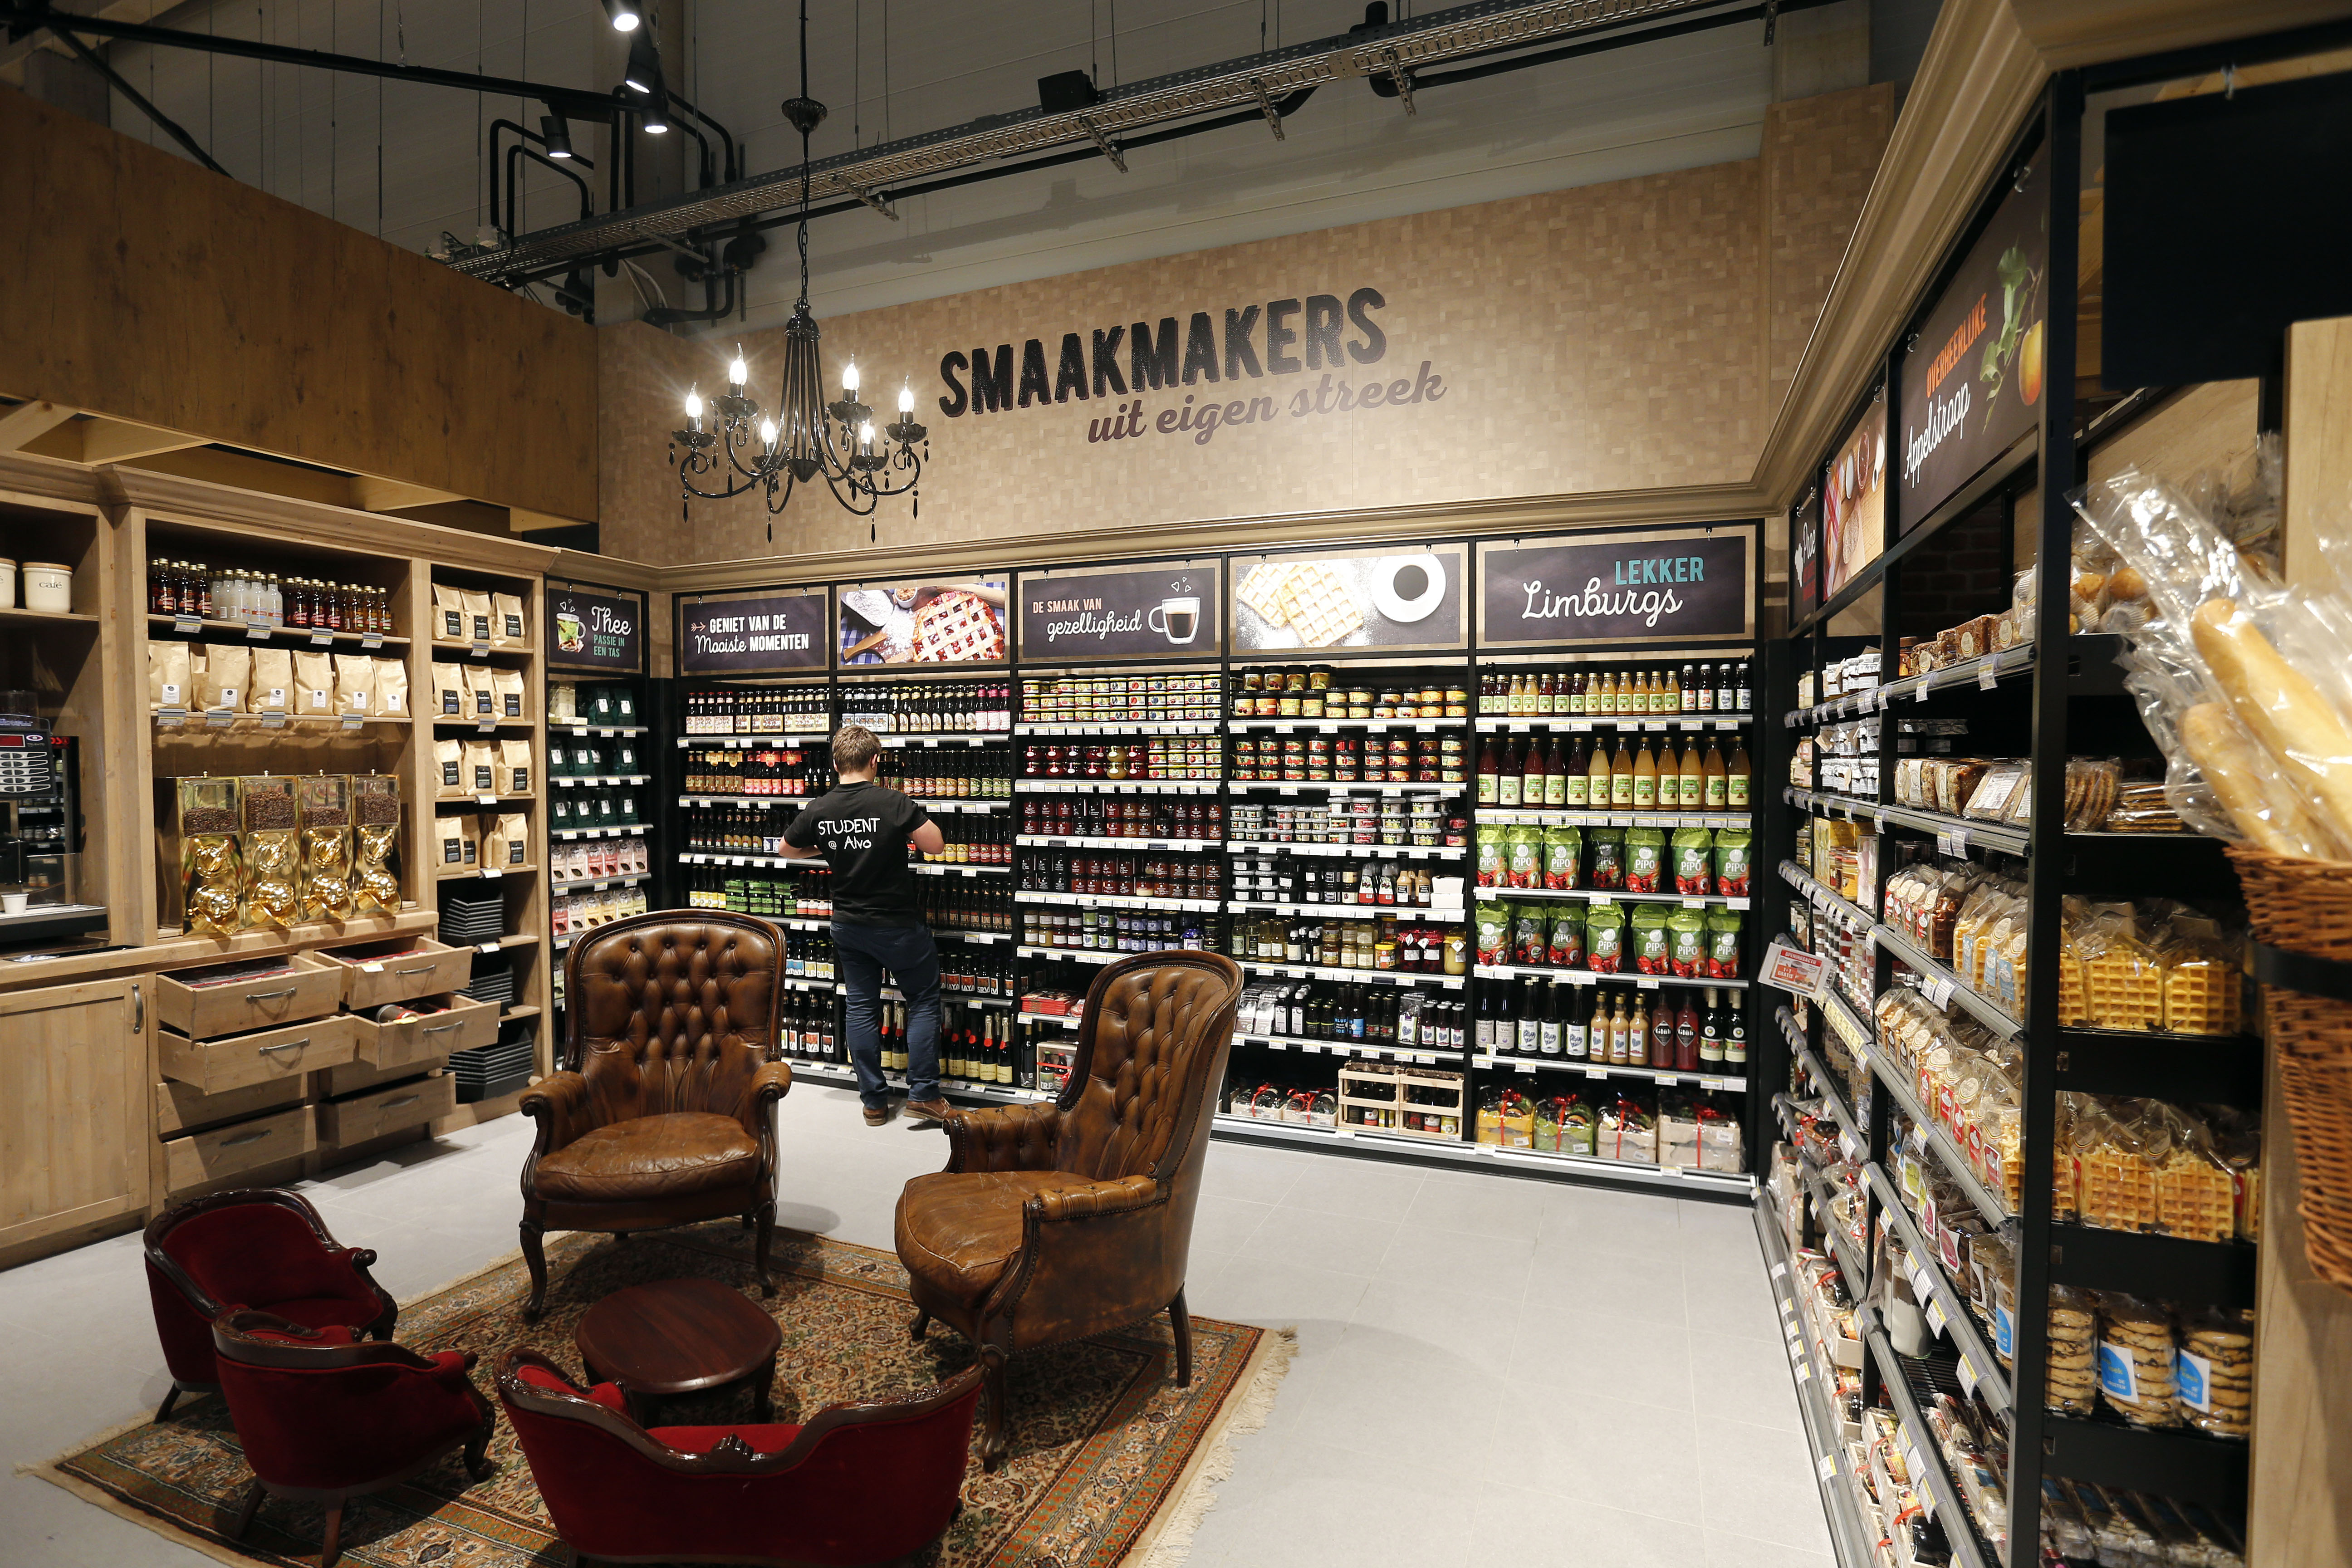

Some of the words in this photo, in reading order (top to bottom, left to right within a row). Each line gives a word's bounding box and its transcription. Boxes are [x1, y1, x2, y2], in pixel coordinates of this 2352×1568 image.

[939, 287, 1387, 418] SMAAKMAKERS
[1926, 293, 1987, 398] OVERHEERLIJKE
[1089, 399, 1147, 443] uit
[1156, 394, 1278, 445] eigen
[1289, 361, 1447, 417] streek
[1904, 382, 1971, 489] Appelstroop
[1616, 557, 1704, 585] LEKKER
[1033, 601, 1044, 613] DE
[1047, 599, 1080, 613] SMAAK
[1083, 598, 1102, 611] VAN
[1522, 577, 1683, 627] Limburgs
[591, 606, 631, 635] Thee
[710, 616, 745, 633] GENIET
[748, 615, 769, 632] VAN
[773, 614, 786, 630] DE
[1047, 608, 1142, 642] gezelligheid
[594, 634, 616, 646] PASSIE
[618, 637, 625, 647] IN
[594, 646, 606, 656] EEN
[608, 647, 620, 657] TAS
[695, 635, 747, 654] Mooiste
[750, 633, 809, 652] MOMENTEN
[818, 818, 880, 835] STUDENT
[828, 840, 837, 850] @
[844, 835, 872, 850] Alvo
